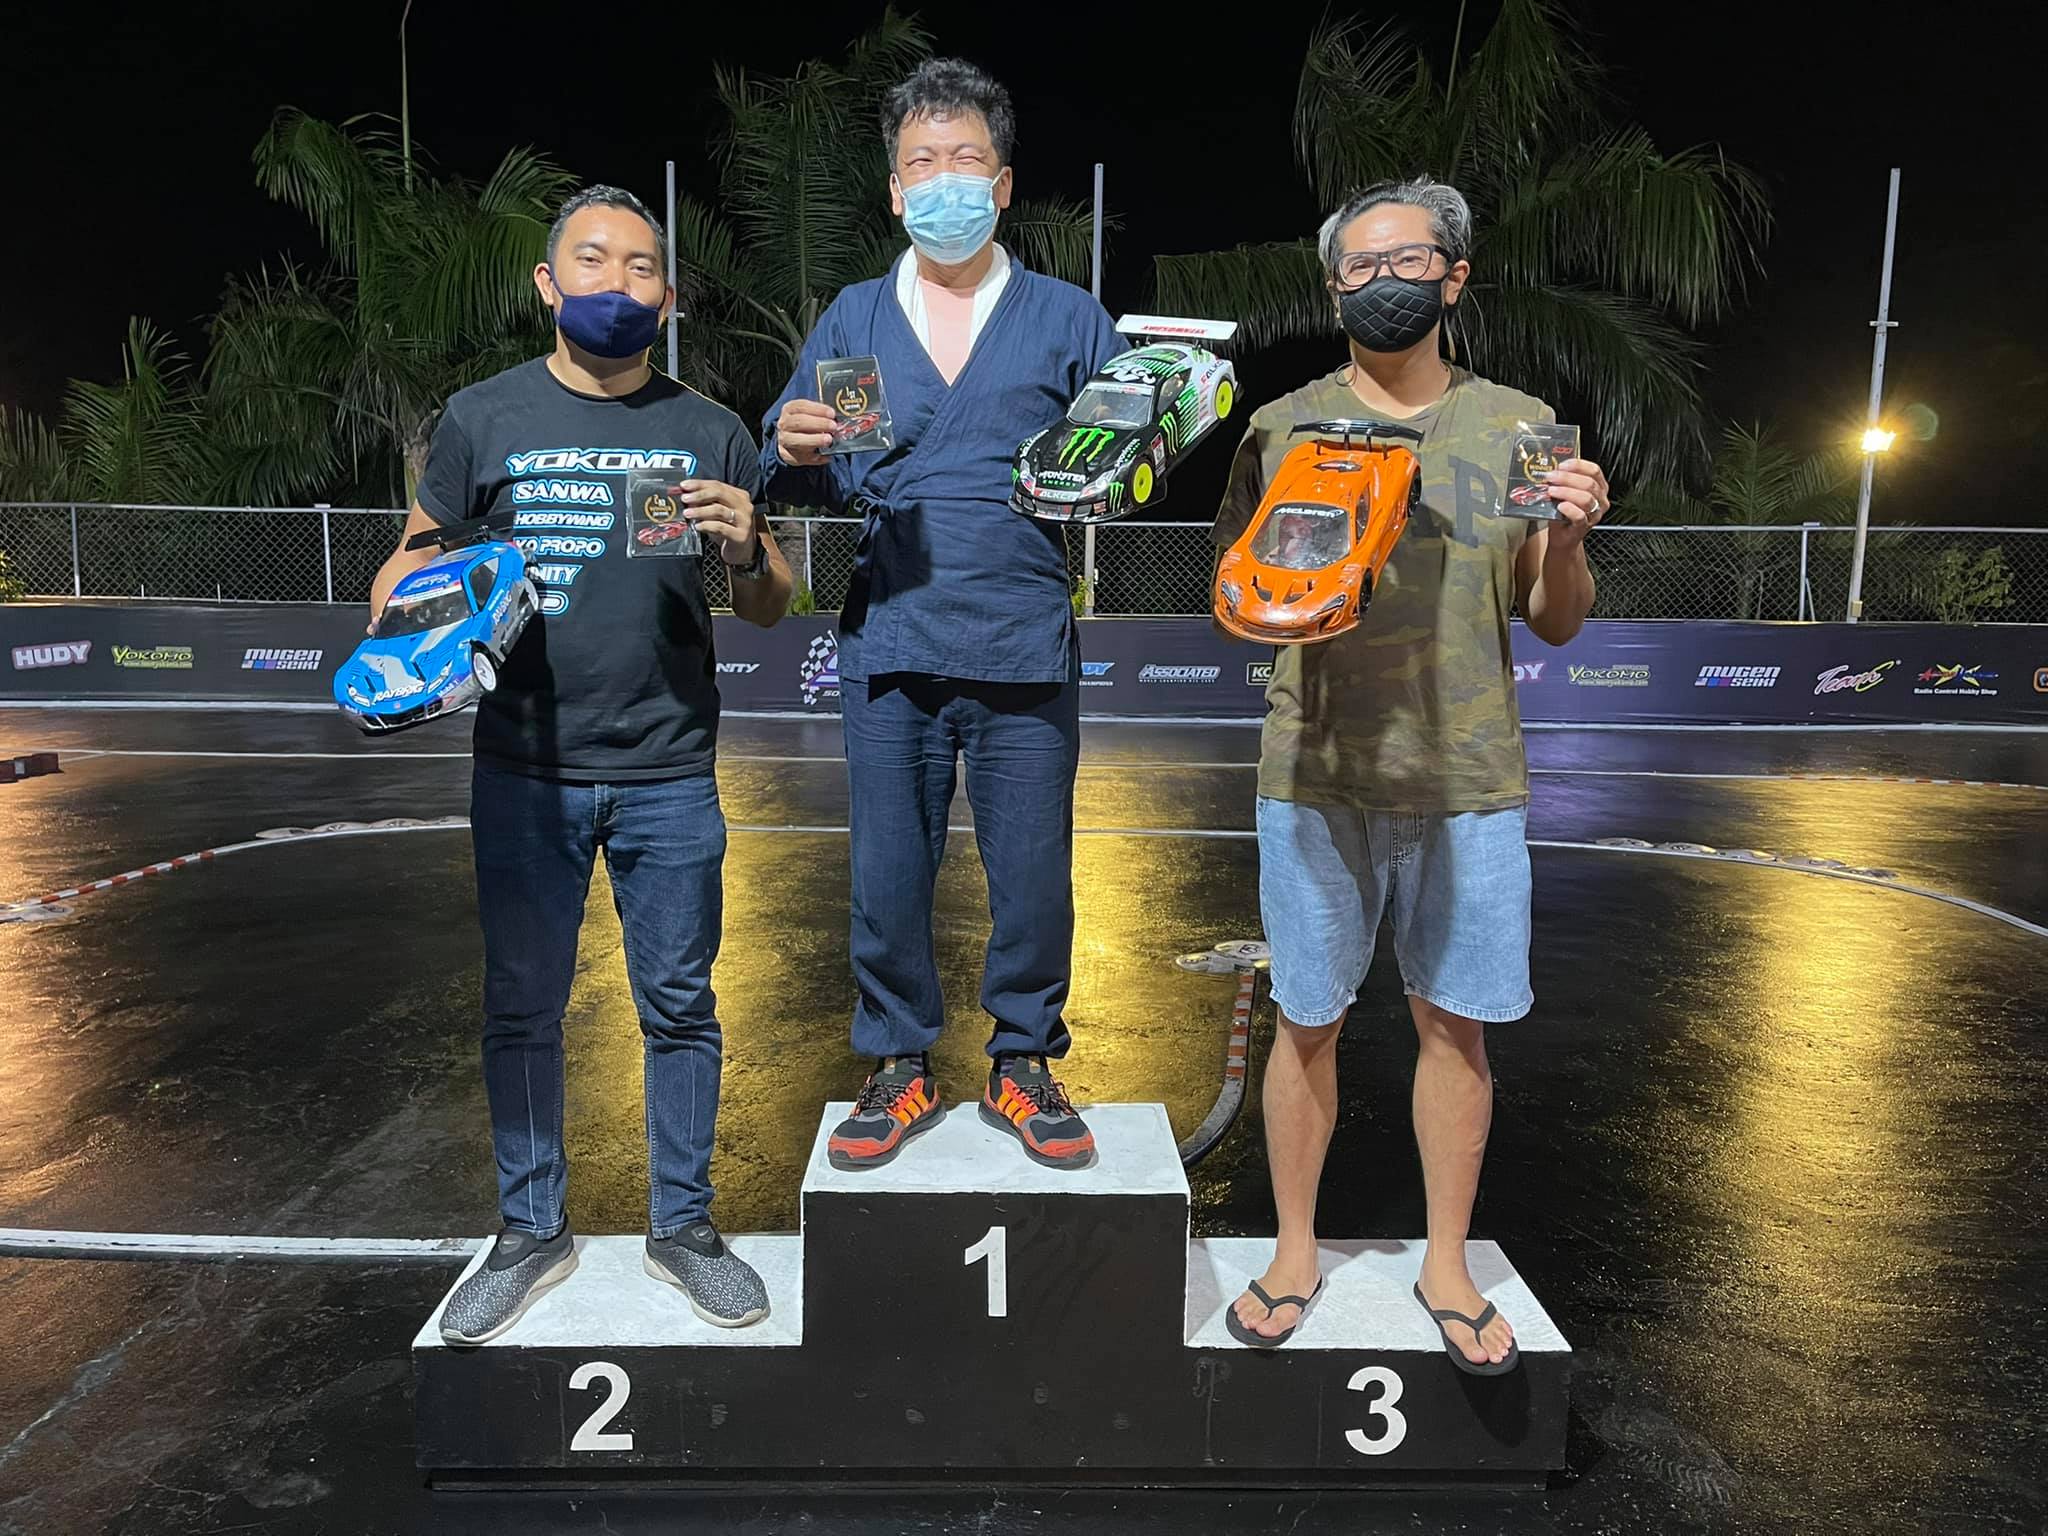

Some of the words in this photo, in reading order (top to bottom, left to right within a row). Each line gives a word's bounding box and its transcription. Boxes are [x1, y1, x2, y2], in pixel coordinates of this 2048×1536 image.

[509, 450, 692, 473] YOKOMO
[515, 483, 610, 502] SANWA
[514, 512, 612, 528] HOBBYWING
[539, 538, 602, 552] PROPO
[15, 644, 89, 666] HUDY
[964, 1226, 1007, 1317] 1
[569, 1361, 633, 1451] 2
[1344, 1366, 1407, 1455] 3
